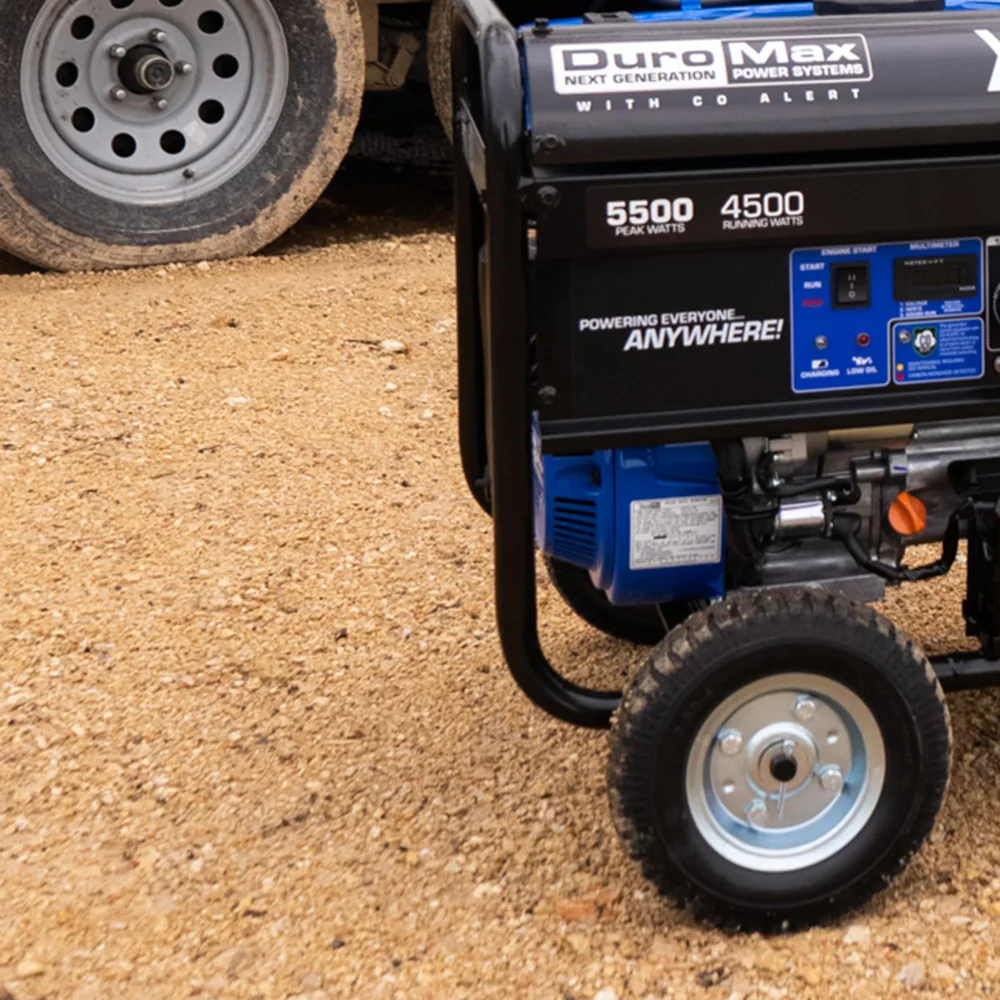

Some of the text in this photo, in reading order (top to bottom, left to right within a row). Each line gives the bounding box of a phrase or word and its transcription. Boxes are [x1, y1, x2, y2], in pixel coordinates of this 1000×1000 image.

[564, 69, 717, 87] NEXT GENERATION
[732, 62, 865, 80] POWER SYSTEMS
[576, 88, 861, 112] WITH CO ALERT
[605, 197, 695, 227] 5500
[720, 191, 805, 219] 4500
[615, 222, 686, 237] PEAK WATTS
[722, 215, 805, 230] RUNNING WATTS
[821, 245, 877, 257] ENGINE START
[909, 241, 960, 251] MULTIMETER
[799, 262, 825, 272] START
[803, 281, 822, 290] RUN
[579, 314, 658, 331] POWERING
[623, 319, 784, 350] ANYWHERE!
[800, 369, 840, 379] CHARGING
[865, 366, 878, 374] OIL
